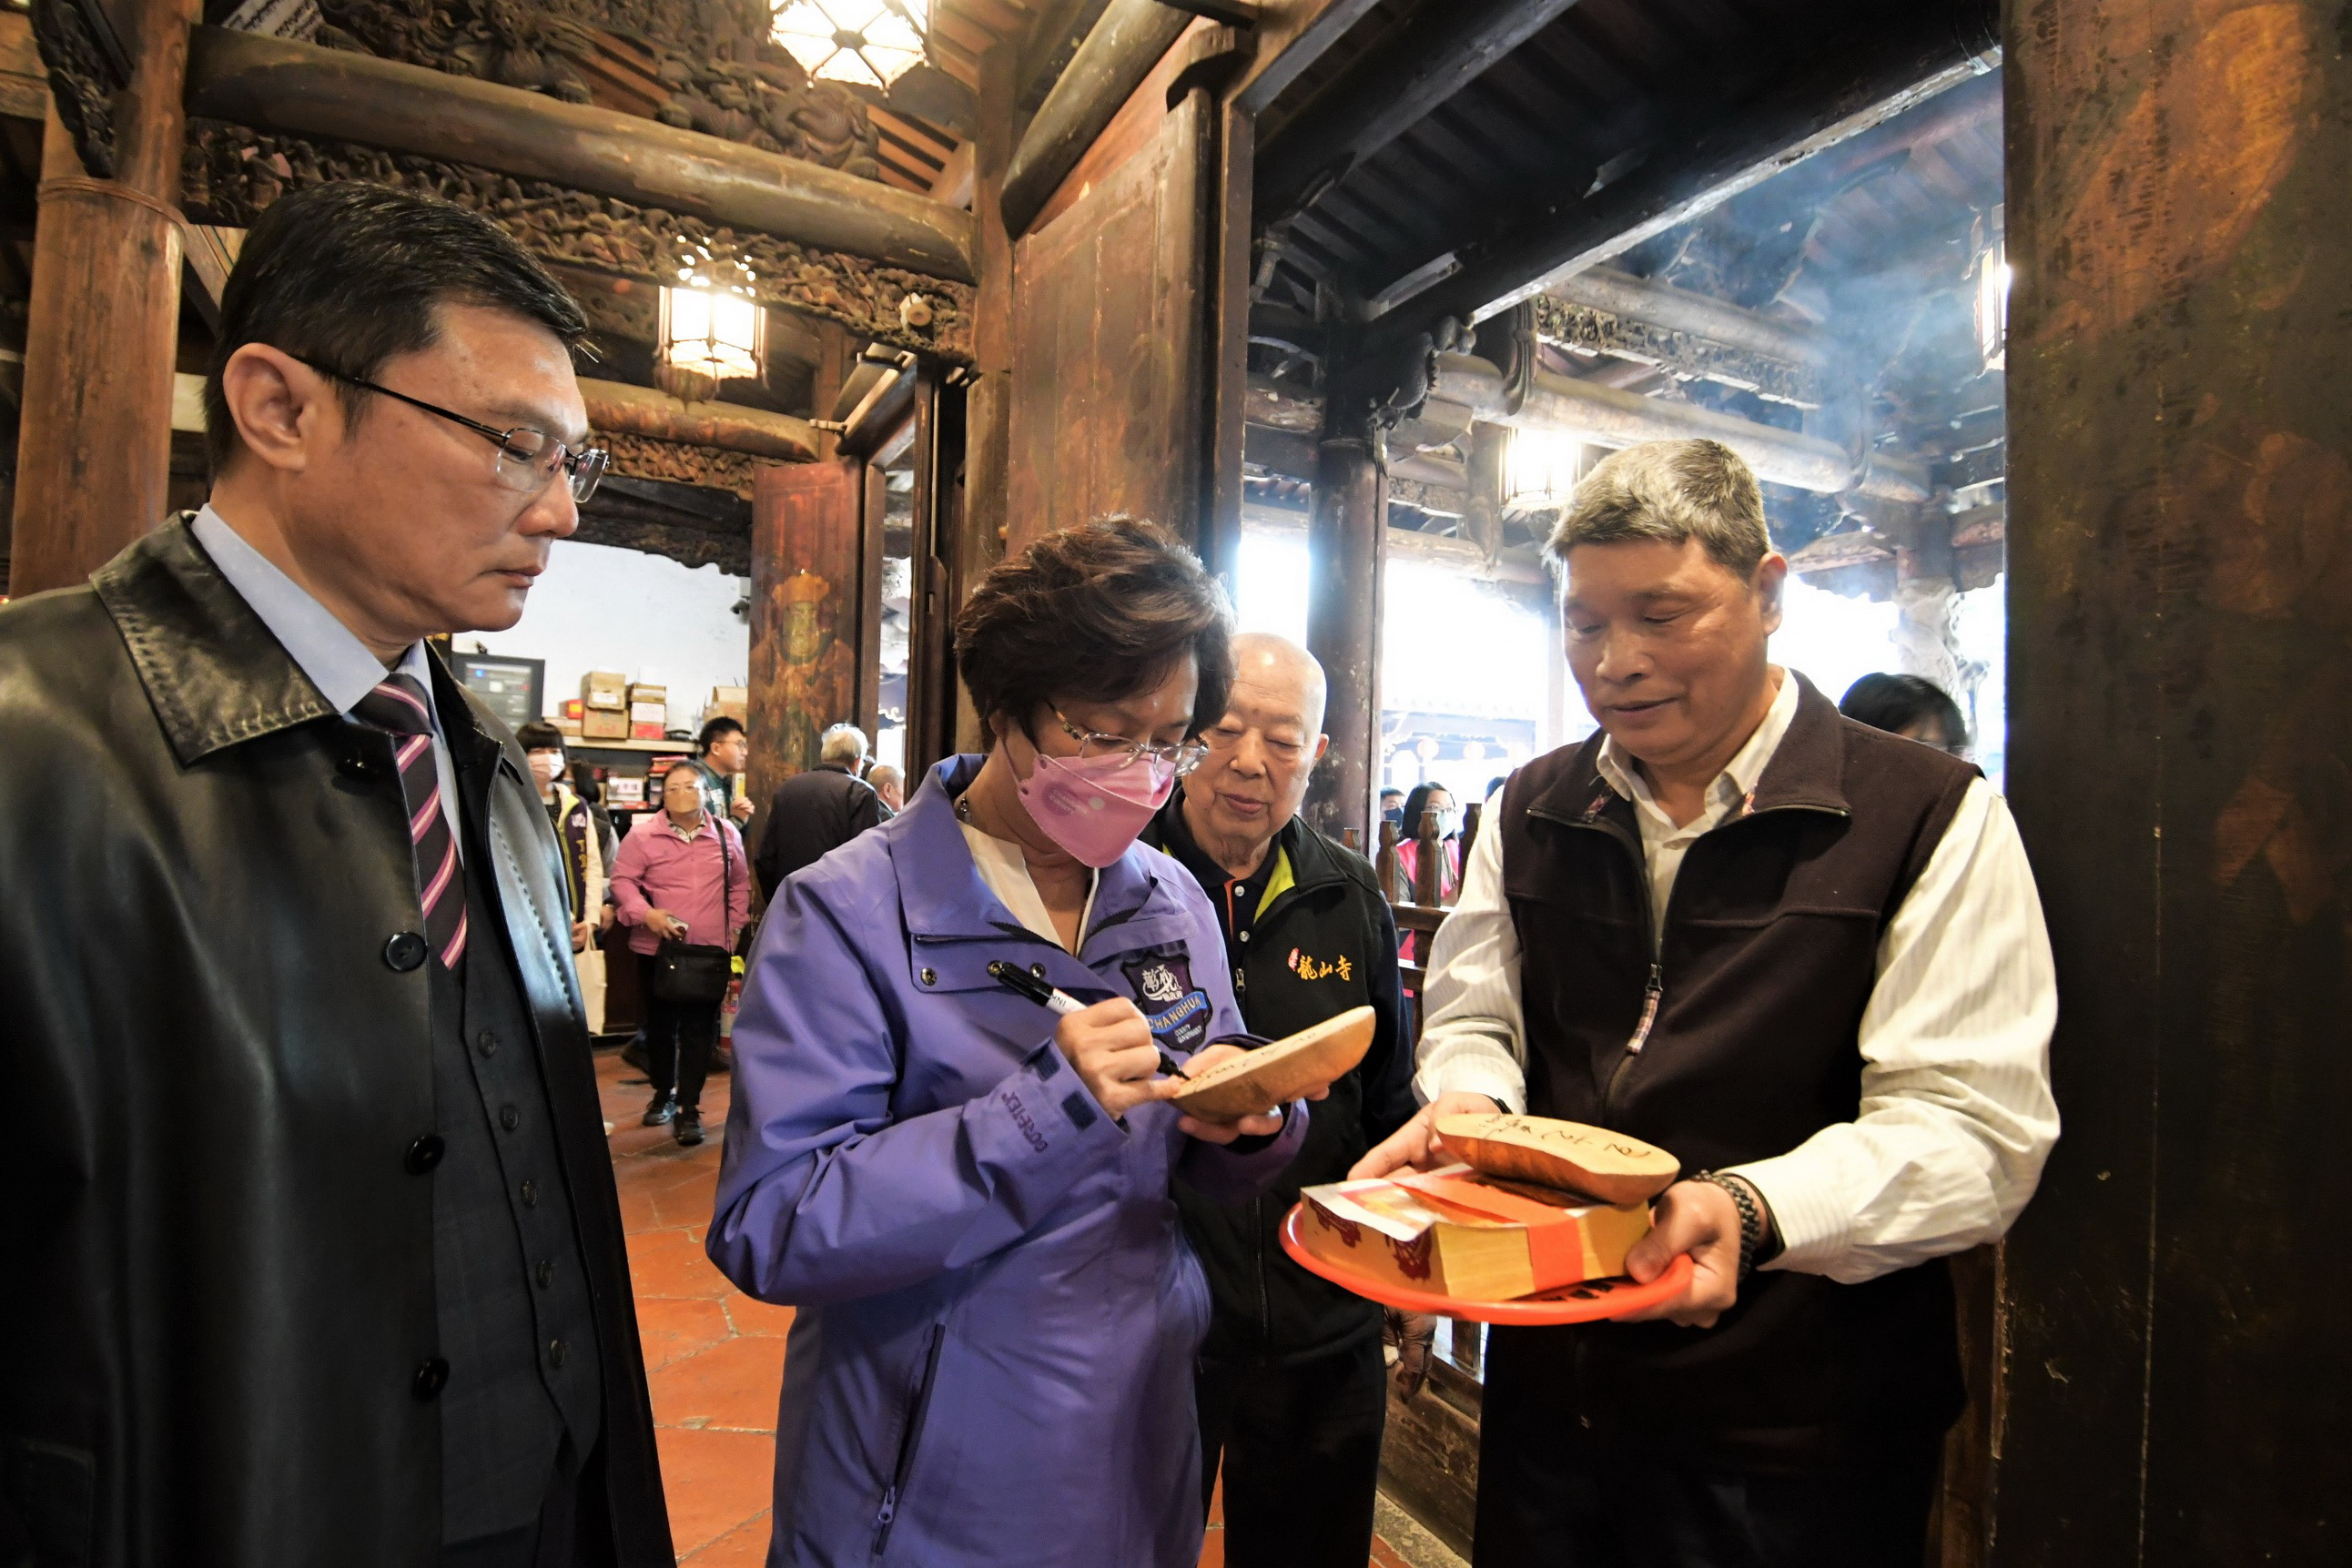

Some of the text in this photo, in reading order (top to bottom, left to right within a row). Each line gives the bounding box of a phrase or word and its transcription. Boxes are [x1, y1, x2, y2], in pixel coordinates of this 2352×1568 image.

[1297, 954, 1353, 981] 龍山寺
[1147, 995, 1202, 1030] CHANGHUA
